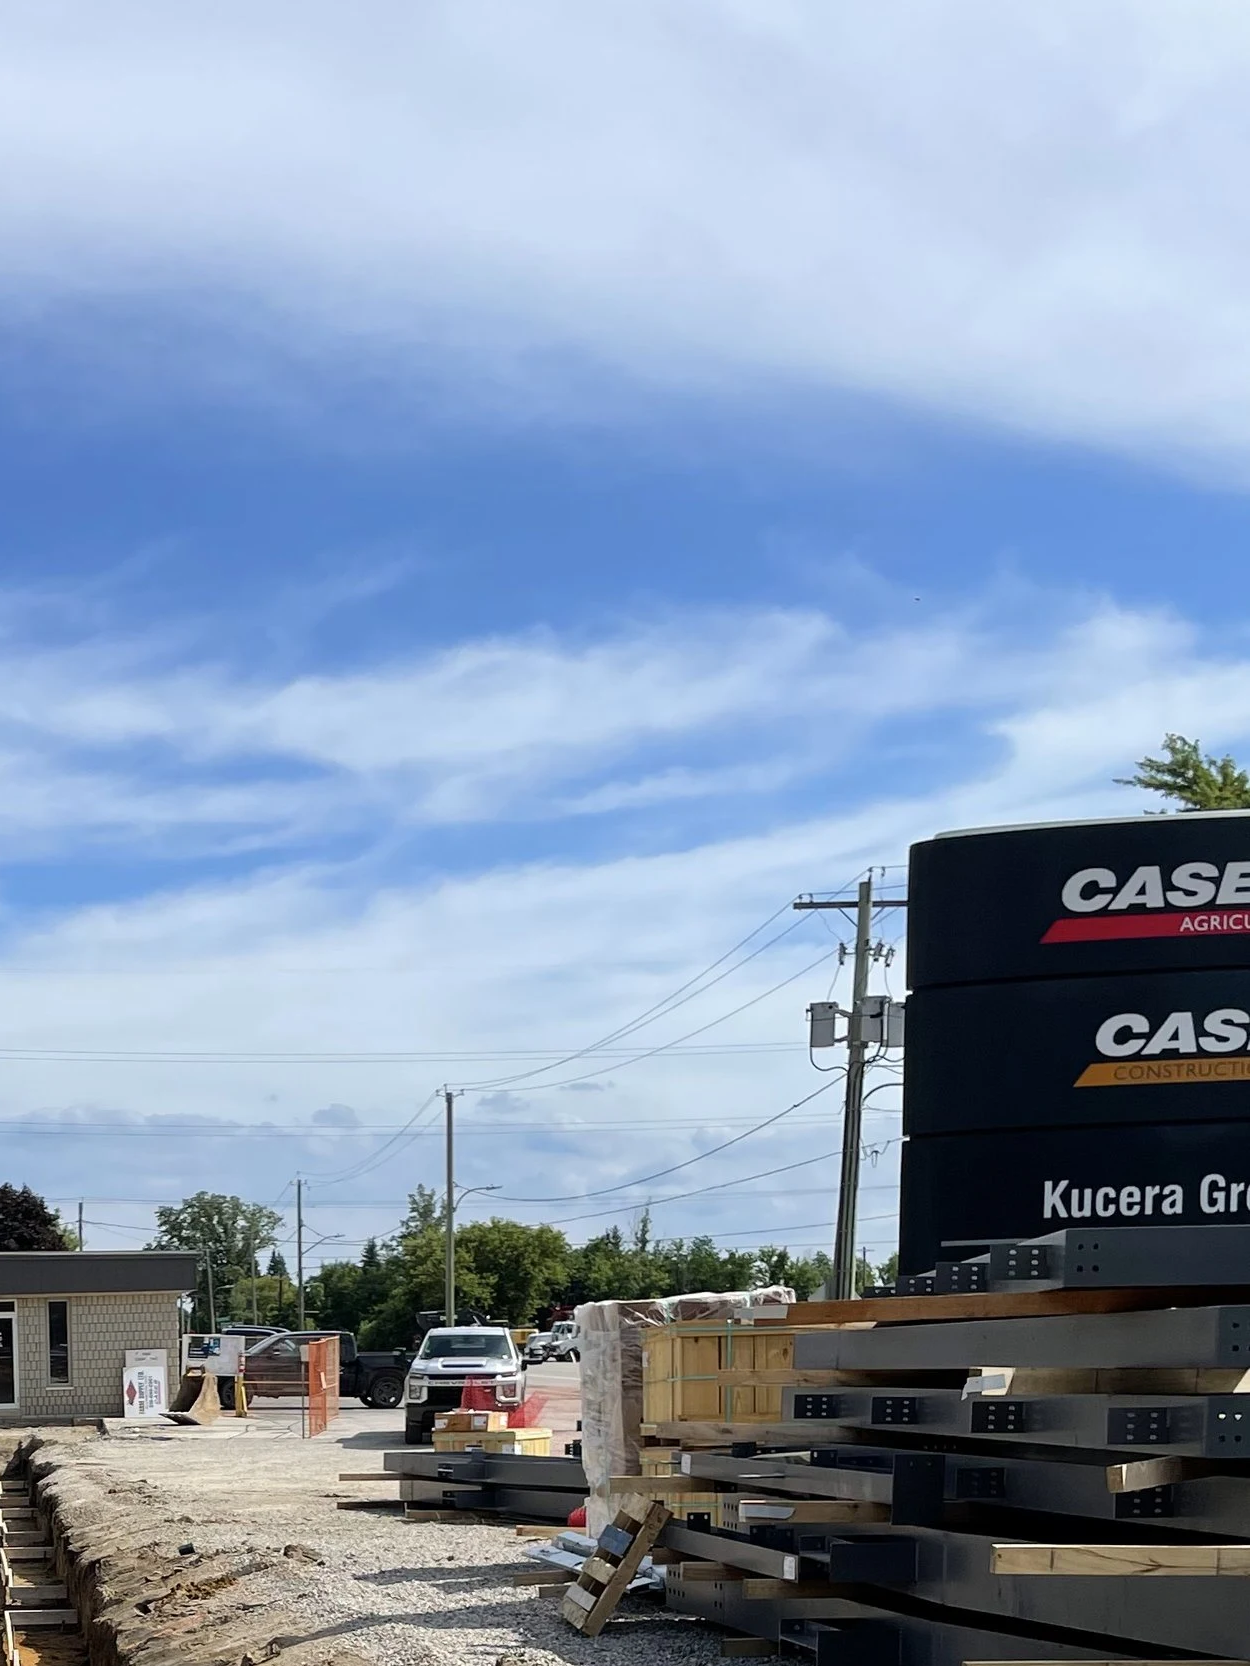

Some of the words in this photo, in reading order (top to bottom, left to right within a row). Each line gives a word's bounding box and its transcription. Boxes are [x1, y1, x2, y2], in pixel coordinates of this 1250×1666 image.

[1061, 861, 1250, 913] CASE
[1095, 1008, 1250, 1057] CAS
[1113, 1061, 1250, 1081] CONSTRUCTI
[1043, 1180, 1183, 1218] Kucera
[1200, 1173, 1250, 1214] Gr
